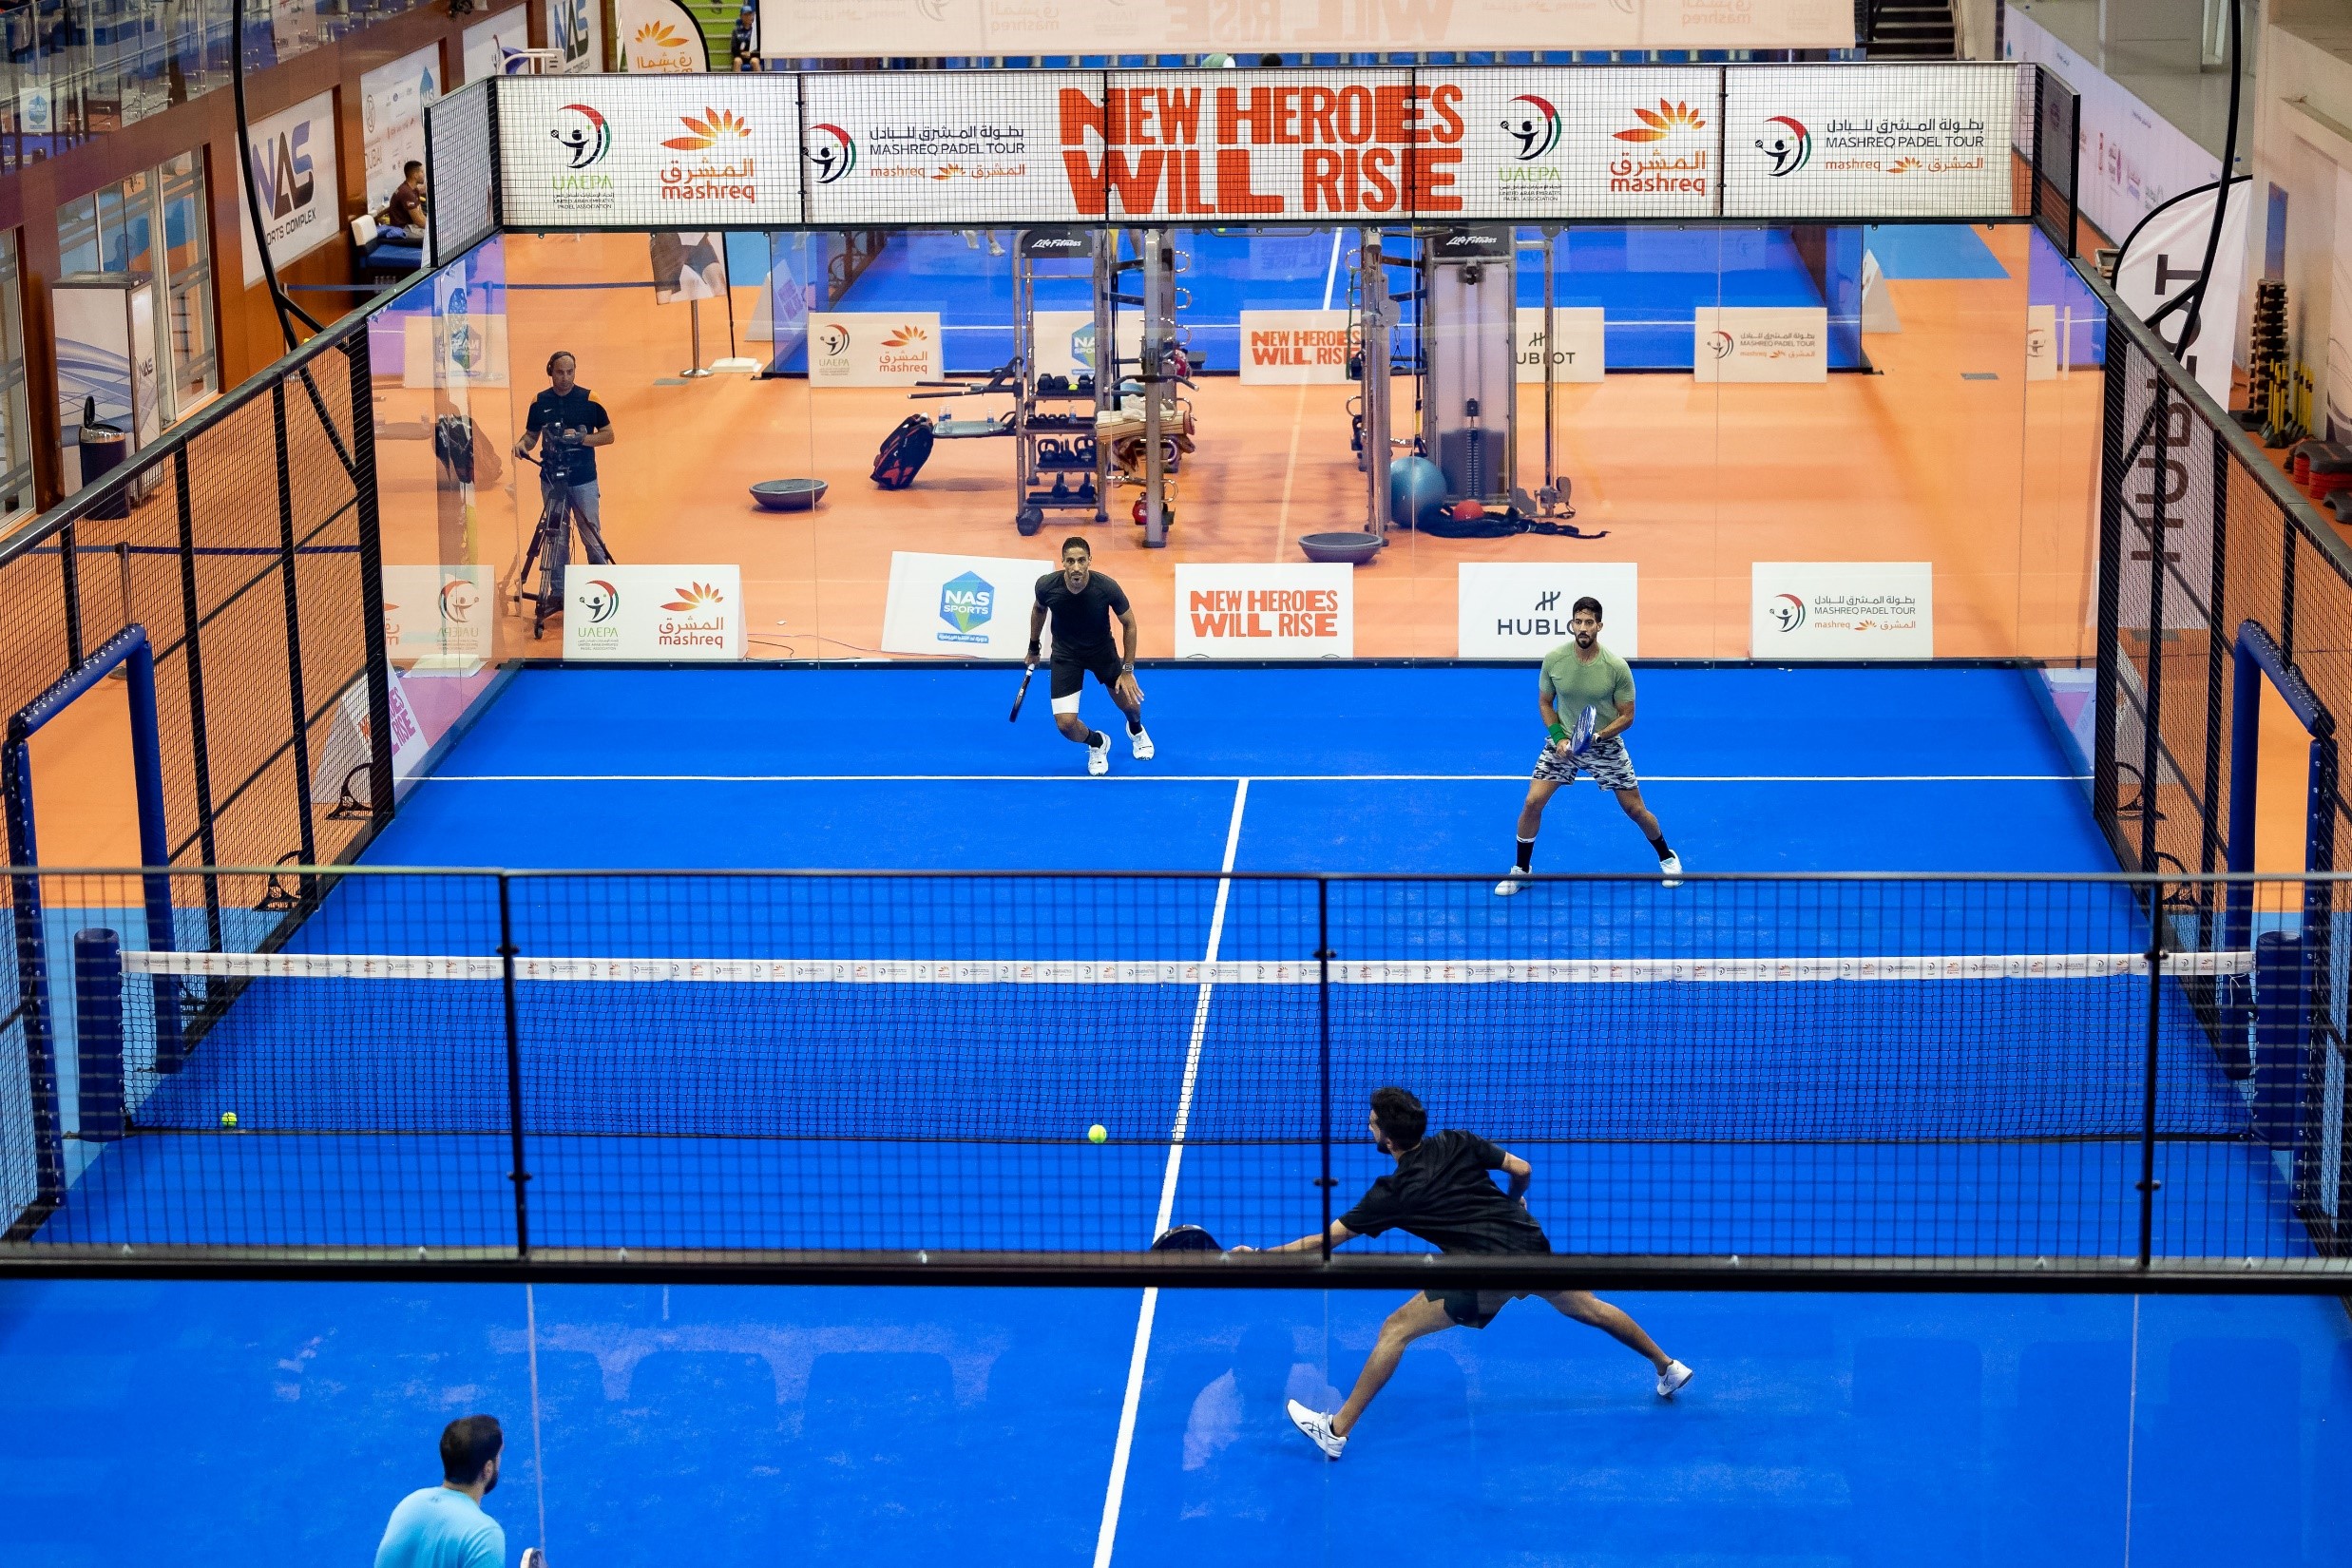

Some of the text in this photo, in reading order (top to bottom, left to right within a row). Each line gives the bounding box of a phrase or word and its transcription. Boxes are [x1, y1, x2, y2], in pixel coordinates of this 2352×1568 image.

[1059, 85, 1464, 144] NEW HEROES
[870, 143, 1024, 156] MASHREQ PADEL TOUR
[1826, 136, 1984, 148] MASHREQ PADEL TOUR
[252, 120, 315, 220] NAS
[870, 164, 925, 178] mashreq
[1826, 157, 1881, 171] mashreq
[552, 175, 613, 189] UAEPA
[1062, 147, 1463, 214] WILL RISE
[1499, 166, 1561, 182] UAEPA
[661, 181, 755, 204] mashreq
[1610, 173, 1706, 197] mashreq
[286, 207, 316, 235] COMPLEX
[1252, 331, 1290, 347] NEW
[1252, 348, 1311, 365] WILL
[1517, 353, 1576, 364] UBOT
[879, 362, 927, 374] mashreq
[945, 589, 990, 606] NAS
[1190, 589, 1338, 611] NEW HEROES
[943, 604, 988, 615] SPORTS
[1814, 606, 1860, 615] MASHREQ
[578, 627, 619, 638] UAEPA
[1191, 613, 1338, 637] WILL RISE
[1497, 619, 1577, 636] HUBL
[1814, 621, 1850, 629] mashreq
[659, 632, 723, 649] mashreq
